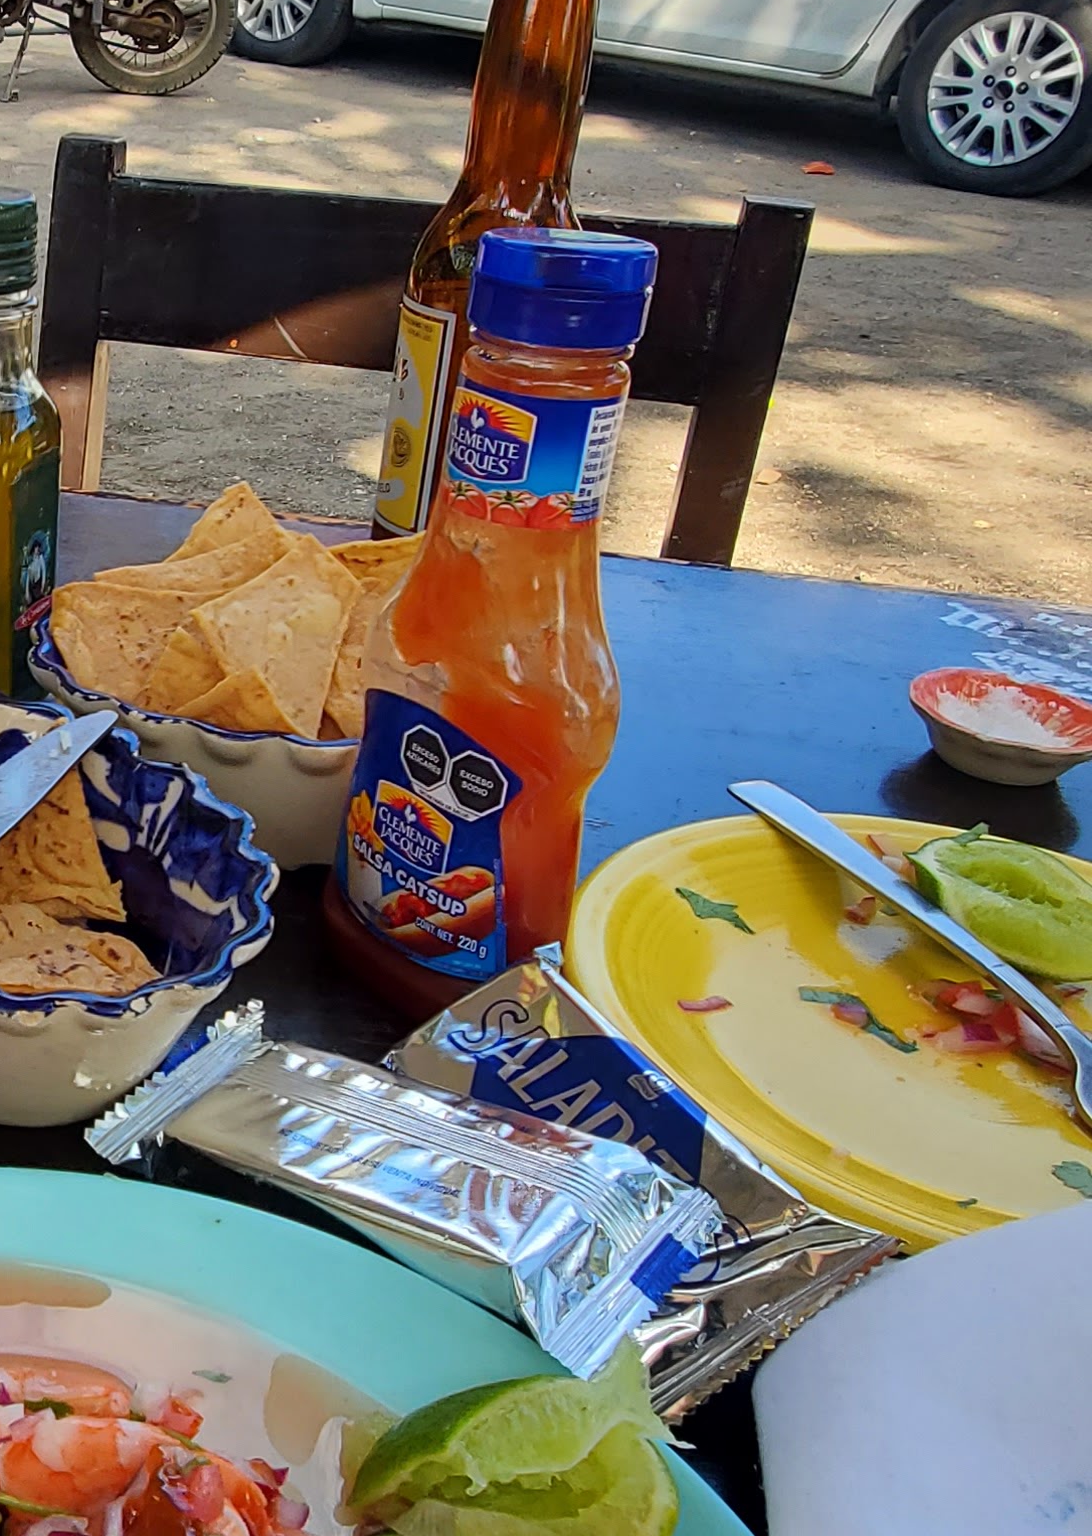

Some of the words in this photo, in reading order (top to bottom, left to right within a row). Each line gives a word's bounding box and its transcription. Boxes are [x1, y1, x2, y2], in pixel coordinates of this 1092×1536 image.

[449, 439, 509, 476] JACQUES
[459, 769, 494, 789] EXCESO
[461, 780, 488, 797] SODIO
[378, 806, 442, 856] CLEMENTE
[381, 824, 434, 867] JACQUES
[353, 834, 394, 878] SALSA
[395, 869, 467, 916] CATSUP
[415, 917, 437, 936] CONT.
[437, 928, 454, 944] NET.
[457, 935, 478, 953] 220
[478, 946, 488, 959] g
[448, 998, 728, 1244] SALADT
